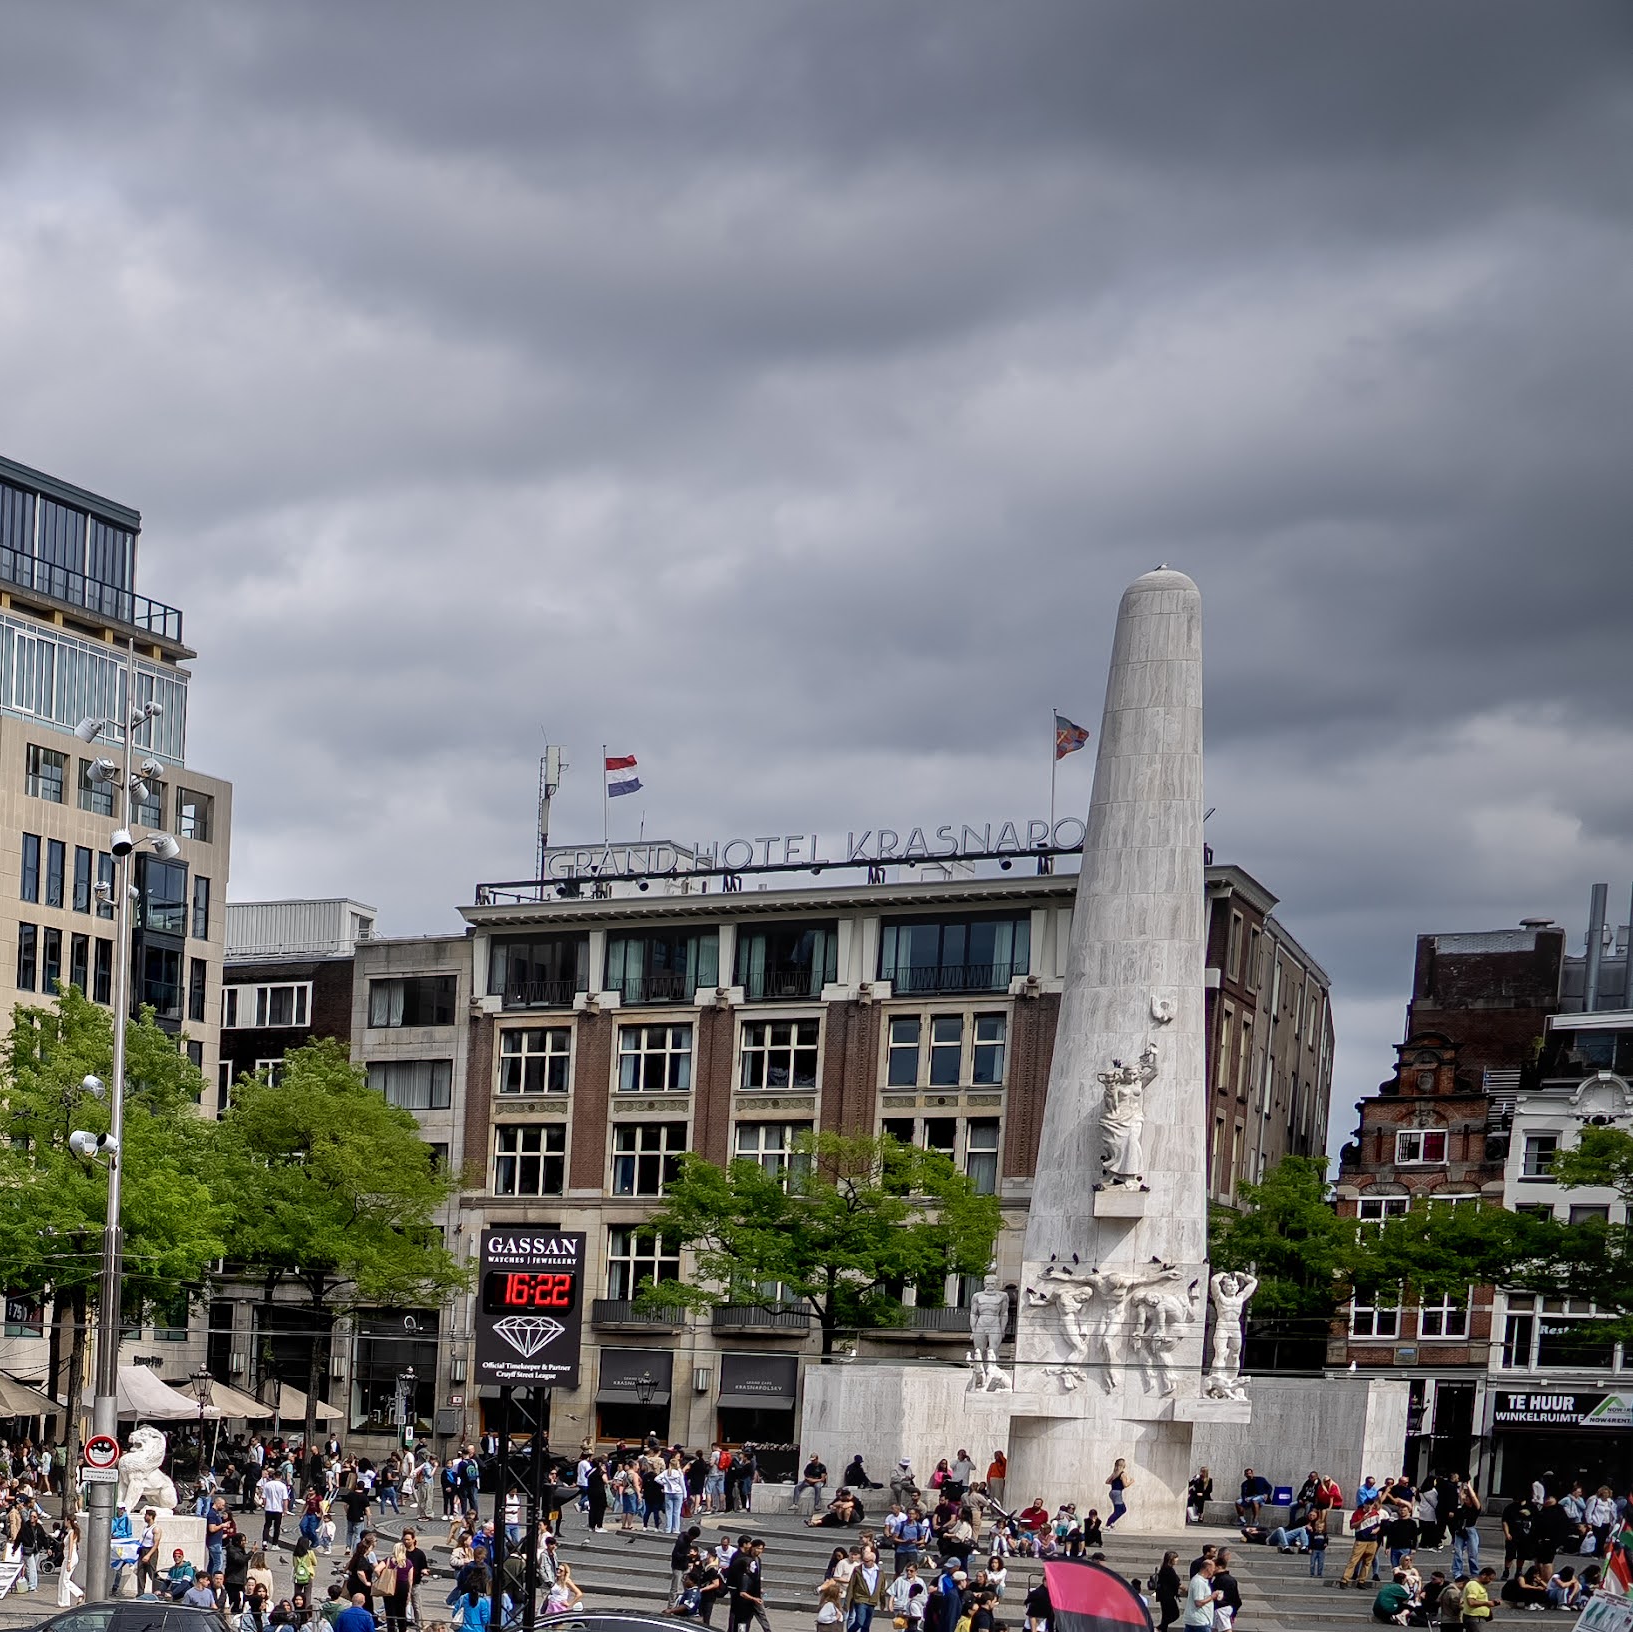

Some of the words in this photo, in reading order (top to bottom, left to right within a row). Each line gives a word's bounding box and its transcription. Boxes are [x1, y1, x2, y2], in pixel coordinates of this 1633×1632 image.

[546, 845, 680, 879] GRAND
[694, 833, 828, 874] HOTEL
[847, 815, 1088, 864] KRASNAPO
[487, 1235, 579, 1256] GASSAN
[487, 1255, 524, 1265] WATCHES
[531, 1257, 577, 1267] JEWELLERY
[505, 1273, 572, 1306] 16:22
[482, 1361, 504, 1369] Official
[505, 1362, 539, 1372] Timekeeper
[549, 1364, 572, 1372] Partner
[495, 1370, 515, 1380] Cruyff
[516, 1371, 533, 1379] Street
[535, 1371, 557, 1381] League
[1507, 1394, 1526, 1410] TE
[1529, 1396, 1575, 1412] HUUR
[1495, 1411, 1585, 1425] WINKELRUIMTE
